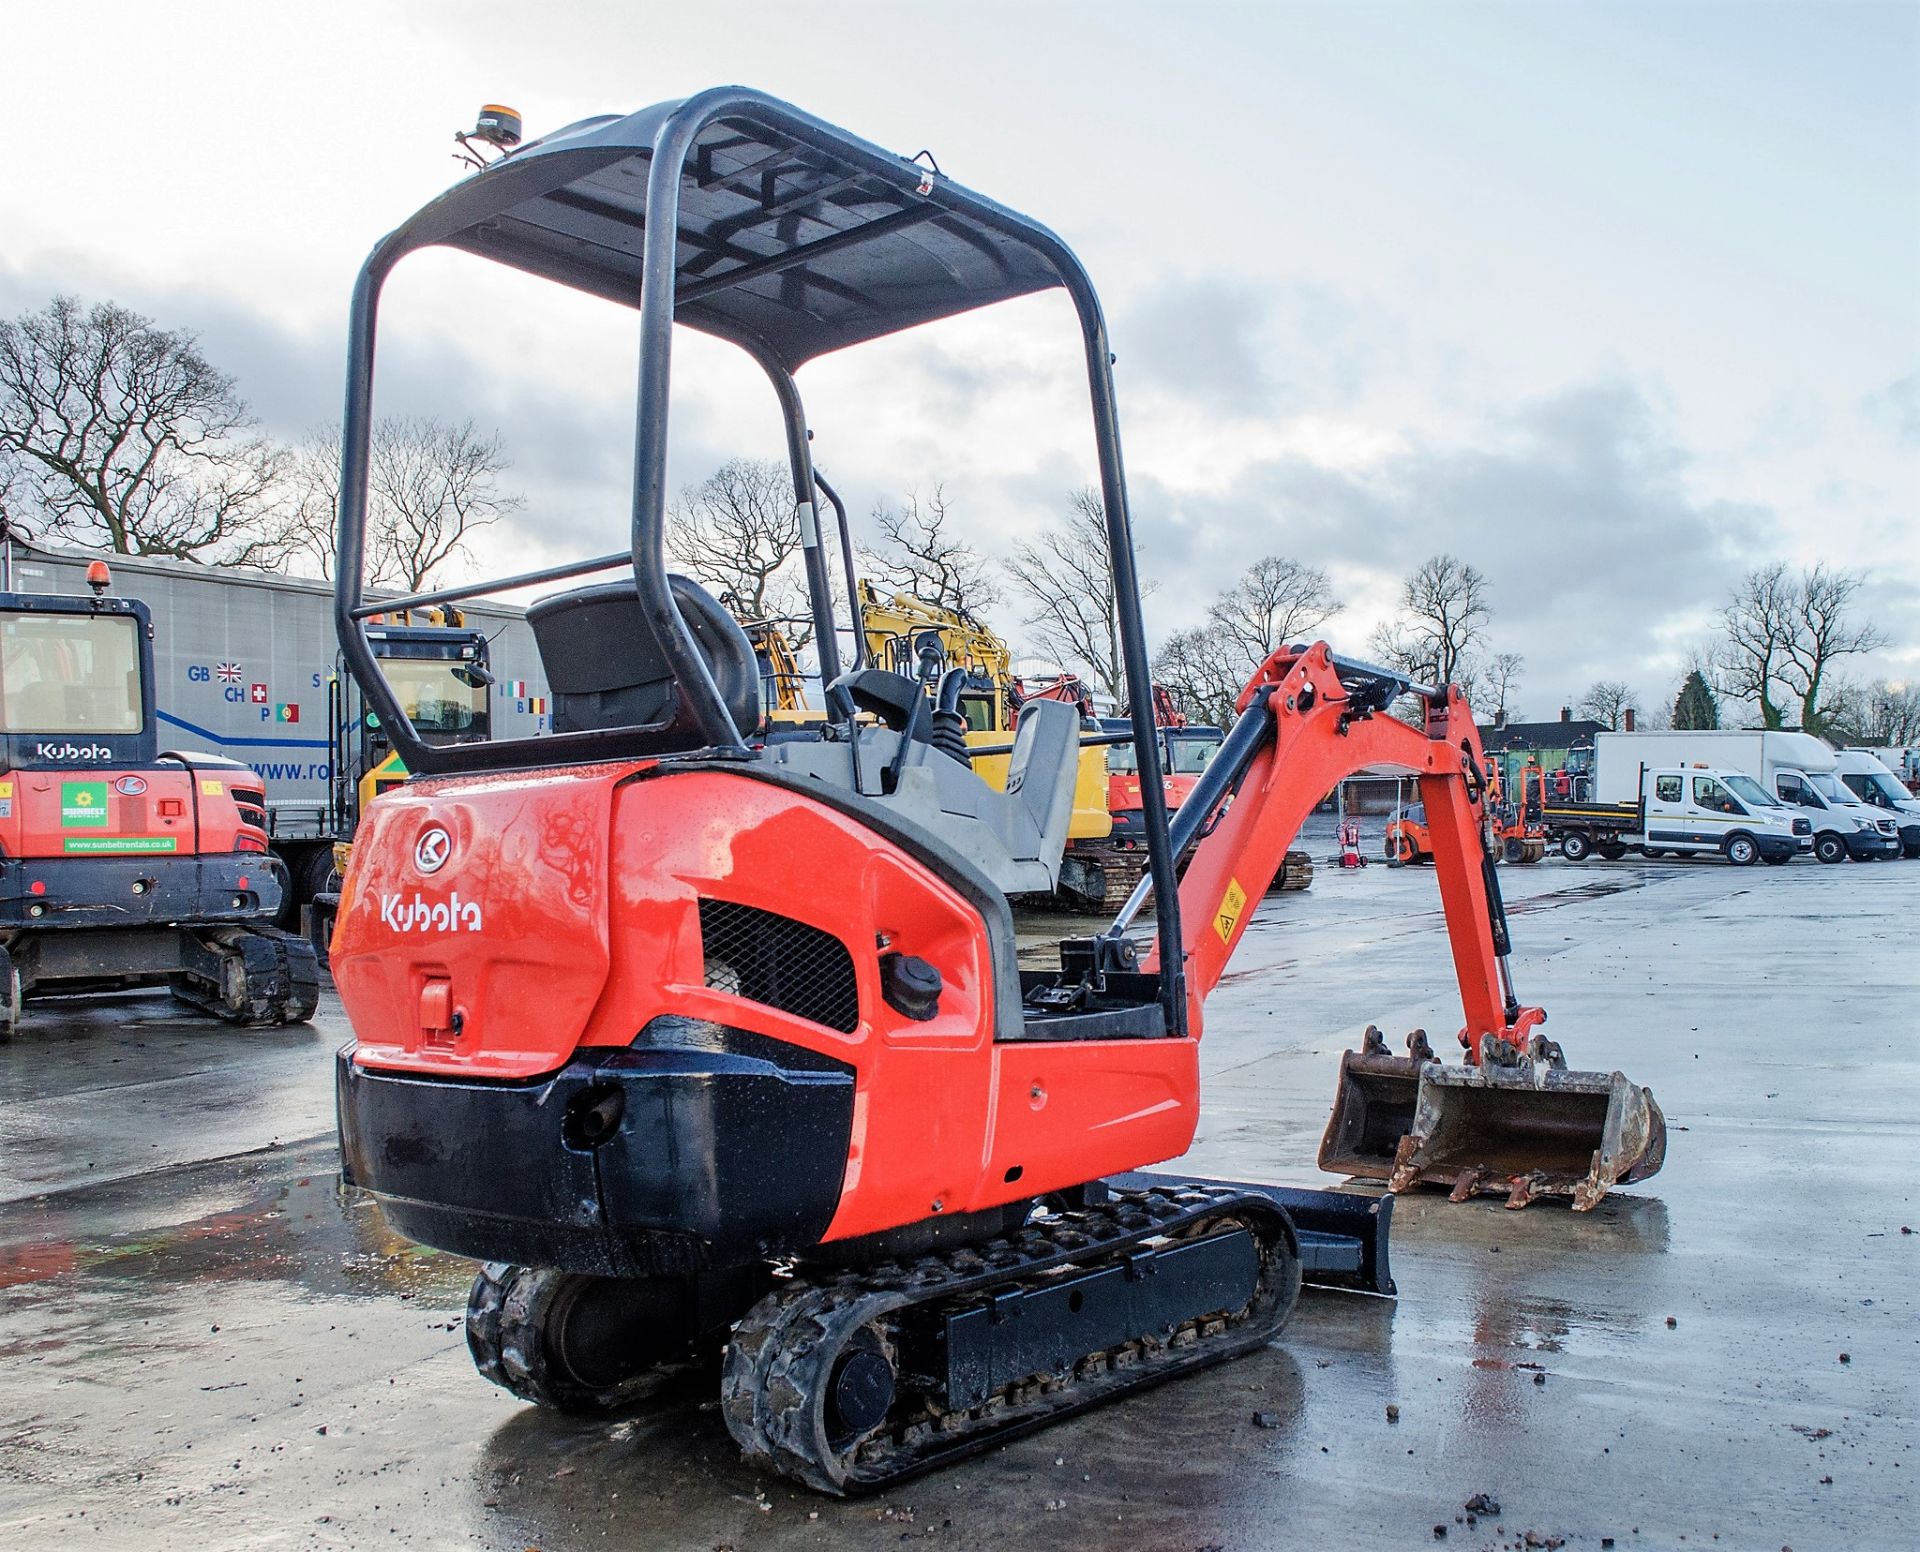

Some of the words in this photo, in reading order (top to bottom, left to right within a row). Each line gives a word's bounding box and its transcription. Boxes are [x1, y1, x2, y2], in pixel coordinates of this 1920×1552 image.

[188, 666, 210, 681] GB
[312, 674, 321, 688] S
[224, 687, 245, 702] CH
[261, 707, 271, 721] P
[517, 701, 524, 714] B
[539, 717, 545, 730] F
[37, 743, 112, 759] Kubota
[68, 840, 173, 850] www.sunbeltrentals.co.uk
[381, 892, 482, 932] Kubota
